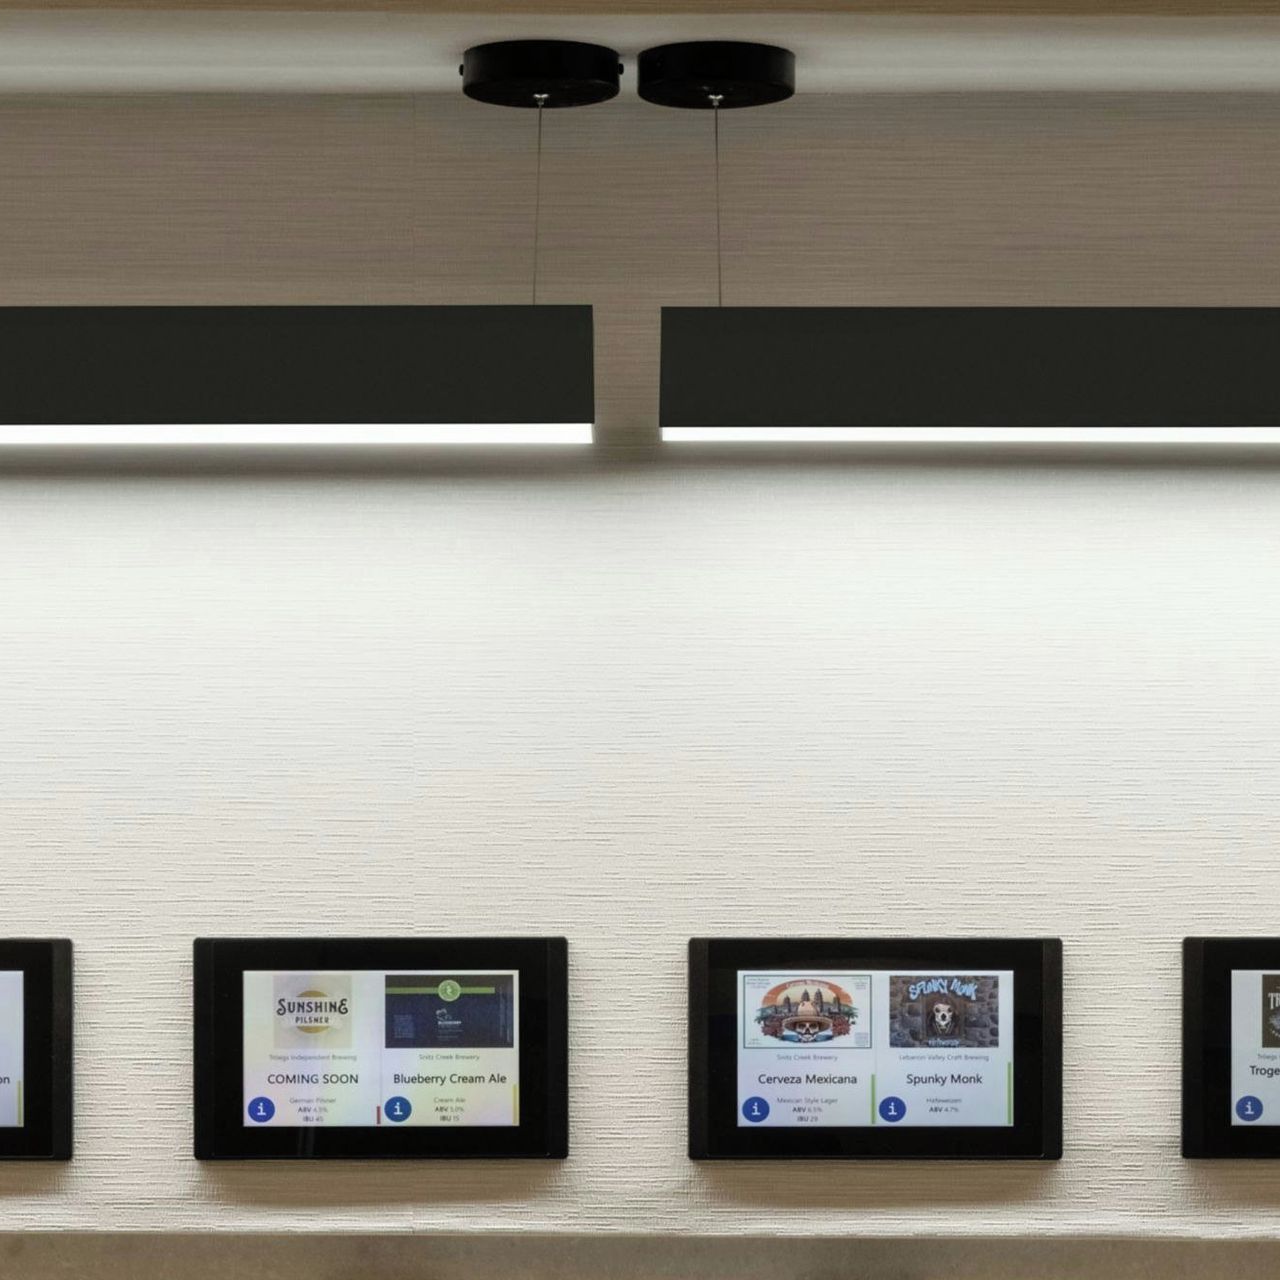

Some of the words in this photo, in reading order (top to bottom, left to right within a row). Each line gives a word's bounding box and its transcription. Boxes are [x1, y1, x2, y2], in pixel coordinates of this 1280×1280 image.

[276, 998, 348, 1016] SUNSHINE
[267, 1074, 319, 1084] COMING
[323, 1074, 358, 1084] SOON
[394, 1074, 446, 1086] Blueberry
[450, 1074, 485, 1084] Cream
[489, 1074, 507, 1083] Ale
[758, 1074, 802, 1084] Cerveza
[806, 1074, 857, 1084] Mexicana
[907, 1074, 947, 1086] Spunky
[951, 1074, 982, 1084] Monk
